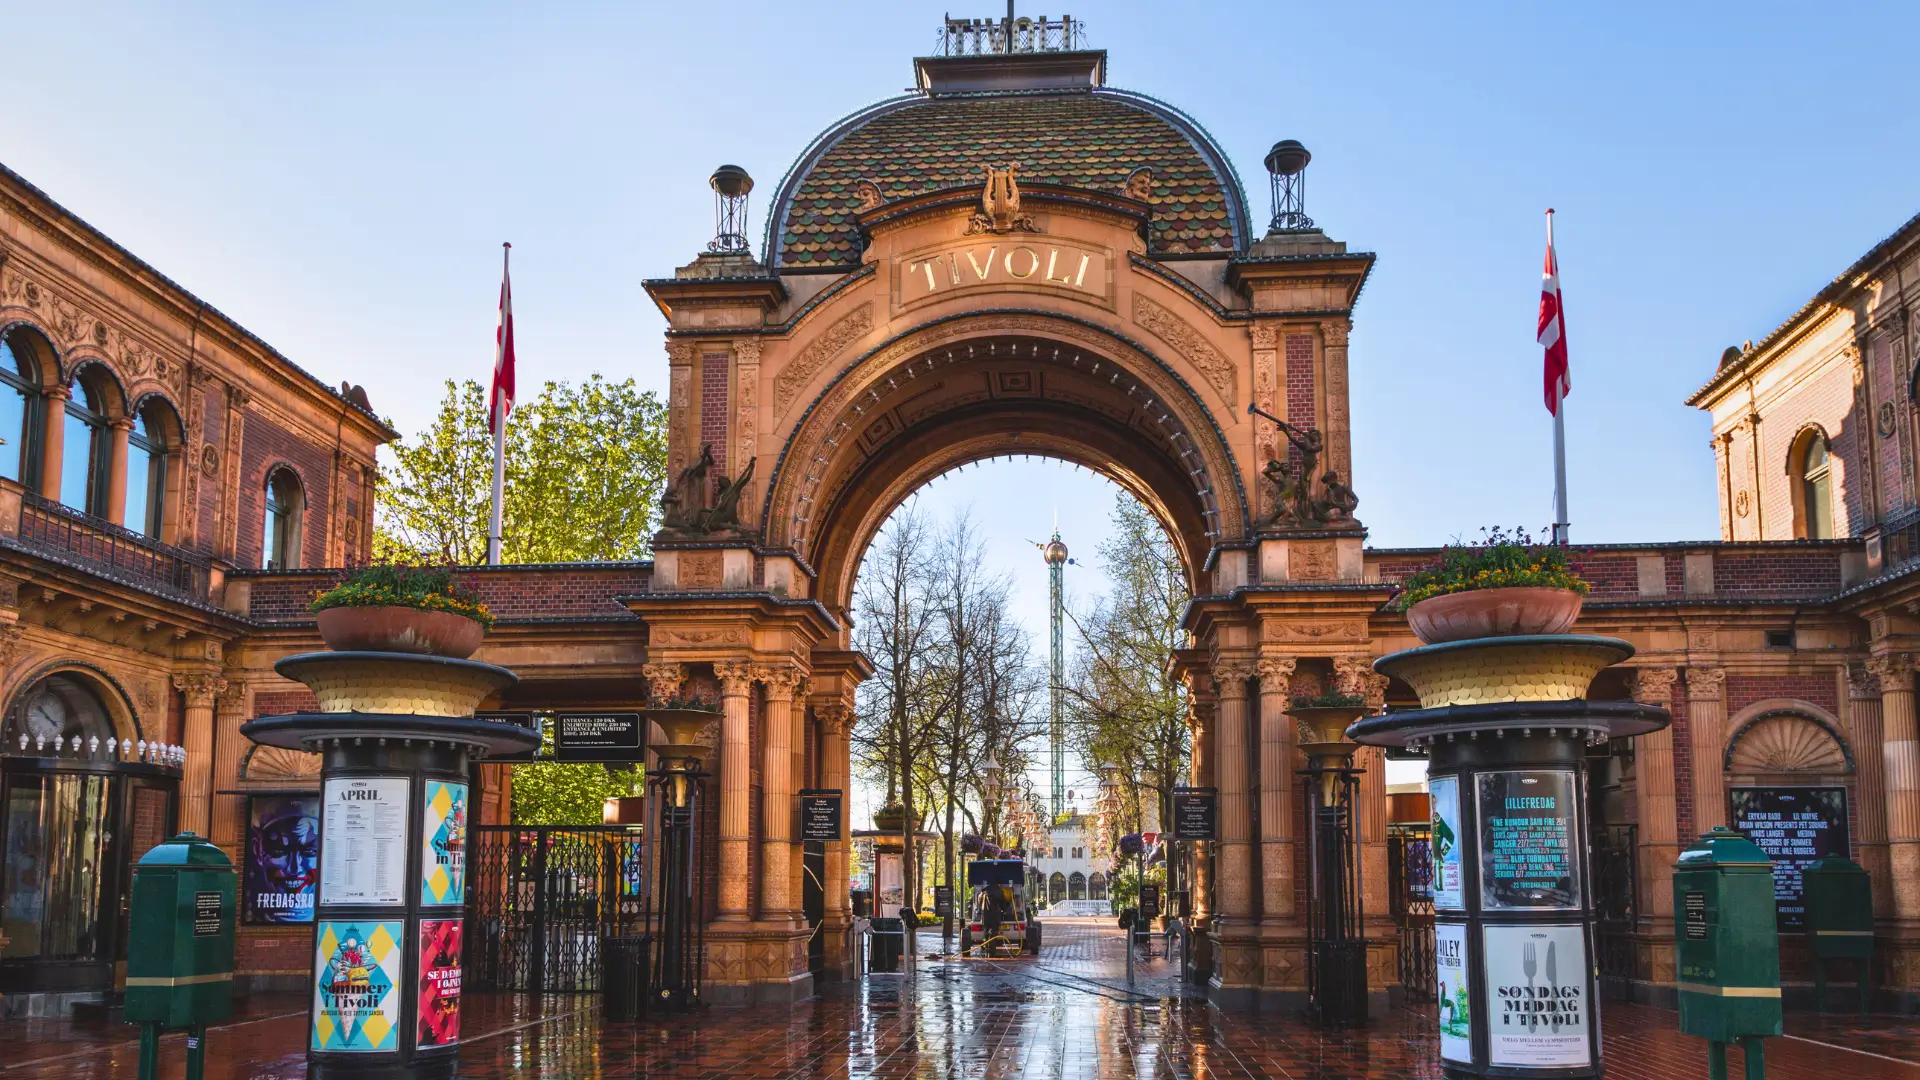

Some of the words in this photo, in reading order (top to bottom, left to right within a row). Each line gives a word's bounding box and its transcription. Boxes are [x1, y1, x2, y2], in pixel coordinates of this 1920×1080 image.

[949, 15, 1070, 55] TIVOLI
[910, 246, 1090, 291] TIVOLI
[339, 790, 382, 800] APRIL
[1505, 797, 1555, 809] LILLEFREDAG
[436, 852, 448, 864] in
[427, 970, 439, 980] SE
[322, 981, 386, 994] Sommer
[325, 995, 329, 1008] i
[331, 995, 379, 1008] Tivoli
[1504, 1000, 1578, 1012] MIDDAG
[1504, 1014, 1510, 1025] I
[1517, 1013, 1580, 1026] TIVOLI
